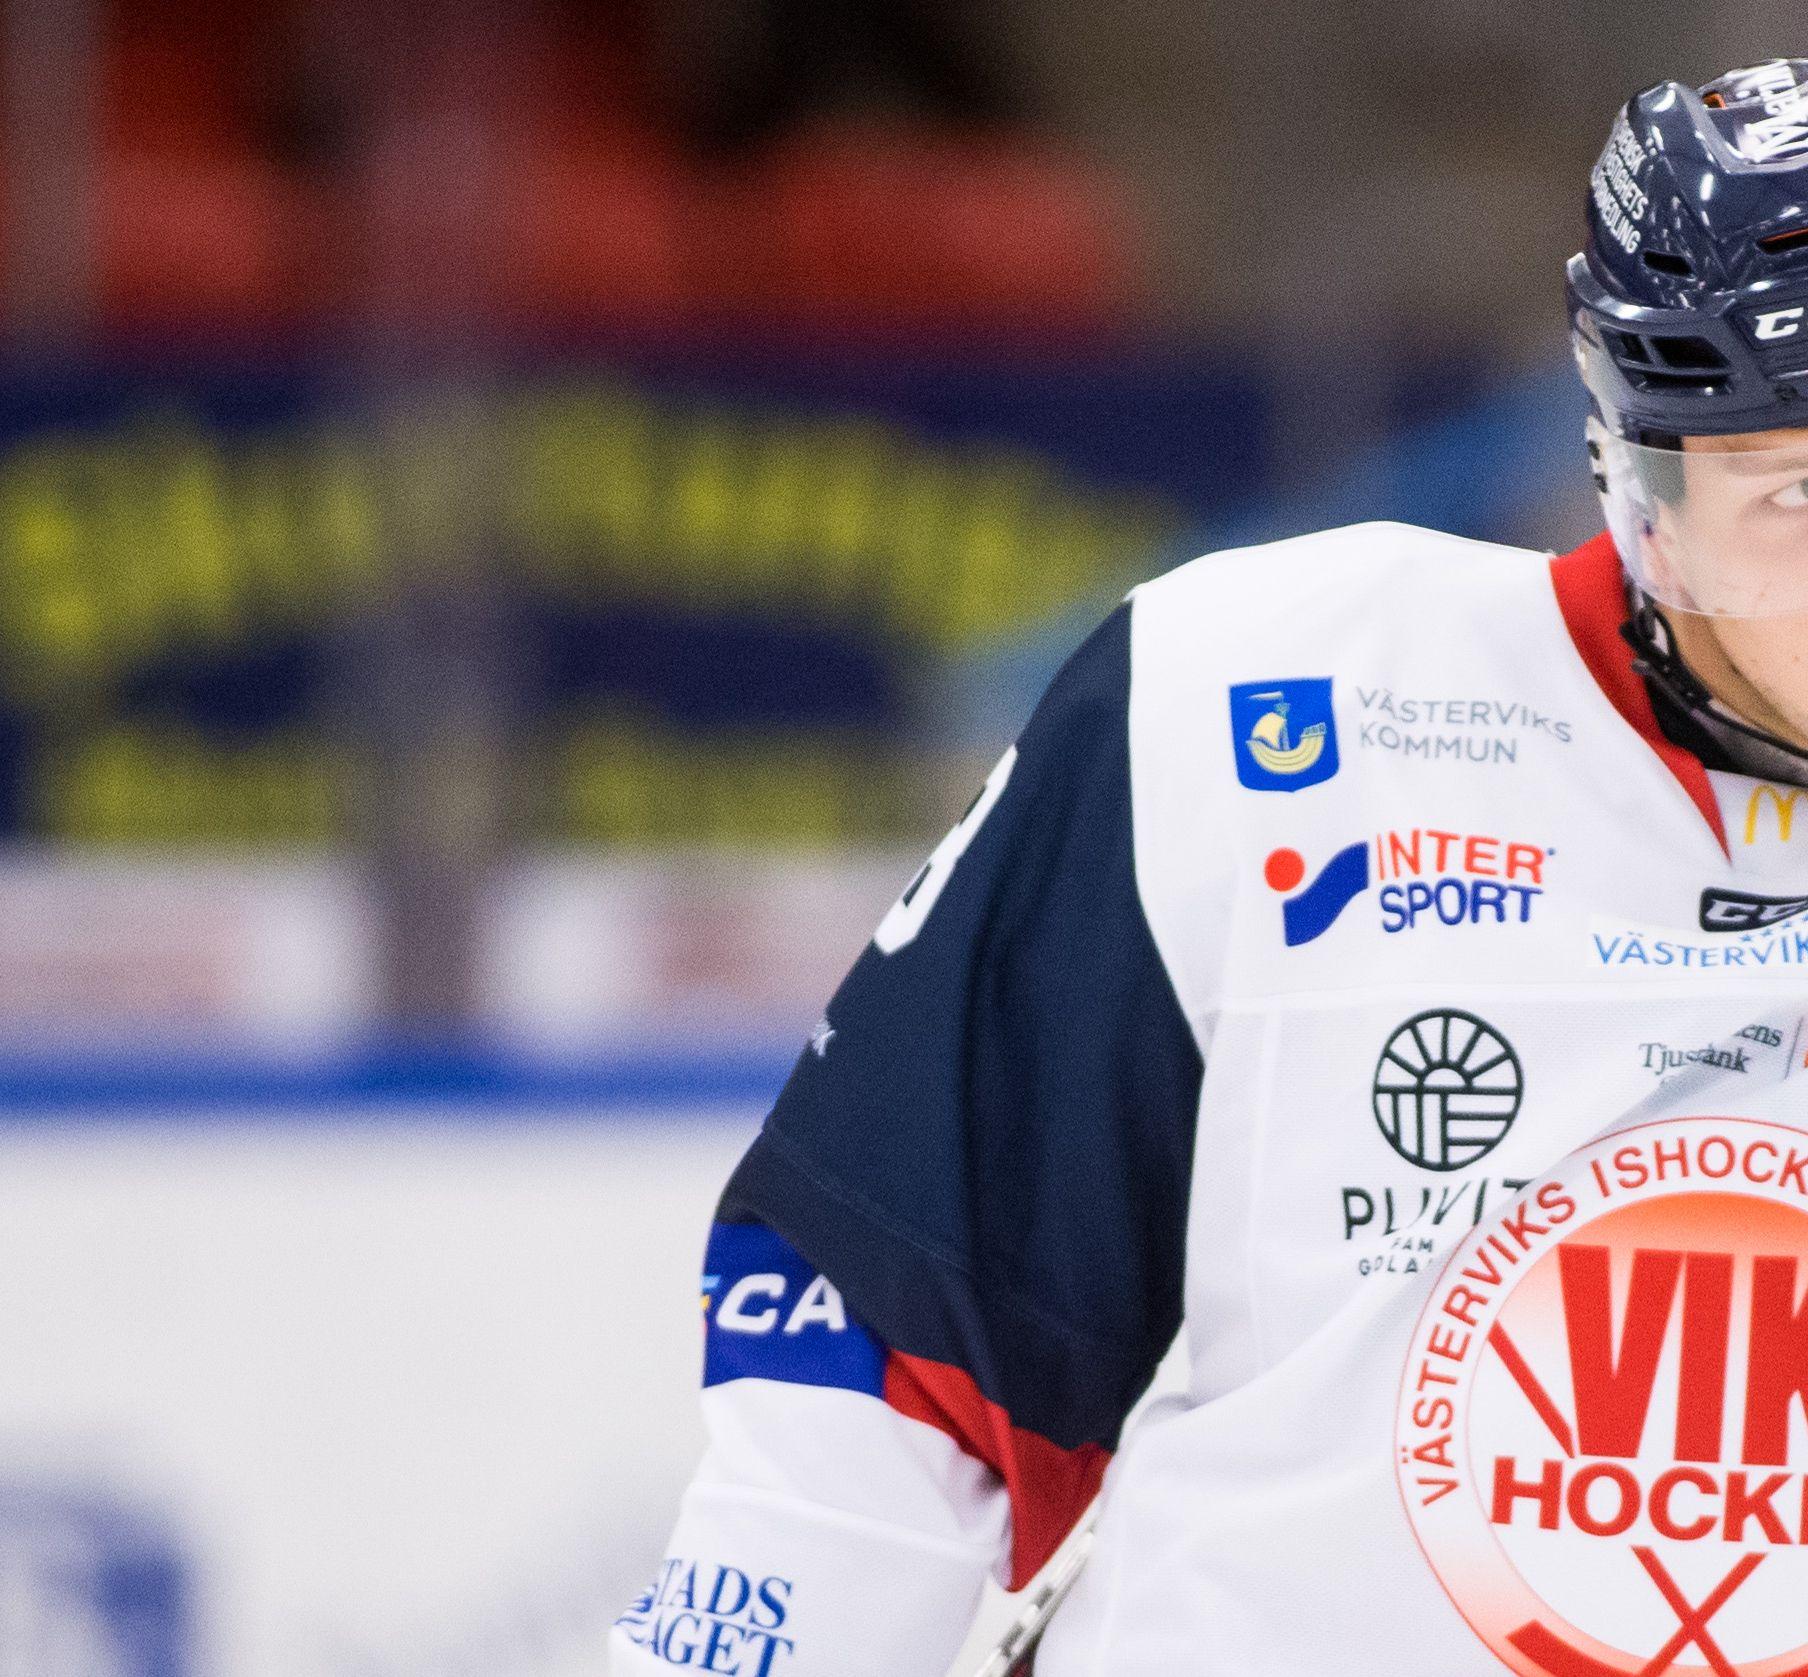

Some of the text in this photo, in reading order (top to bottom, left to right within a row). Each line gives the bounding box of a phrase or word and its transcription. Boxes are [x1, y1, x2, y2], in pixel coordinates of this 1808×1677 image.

[1355, 685, 1573, 744] VÄSTERVIKS
[1360, 721, 1518, 765] KOMMUN
[1376, 828, 1544, 883] INTER
[1379, 877, 1545, 933] SPORT
[1401, 1180, 1578, 1506] VÄSTERVIKS
